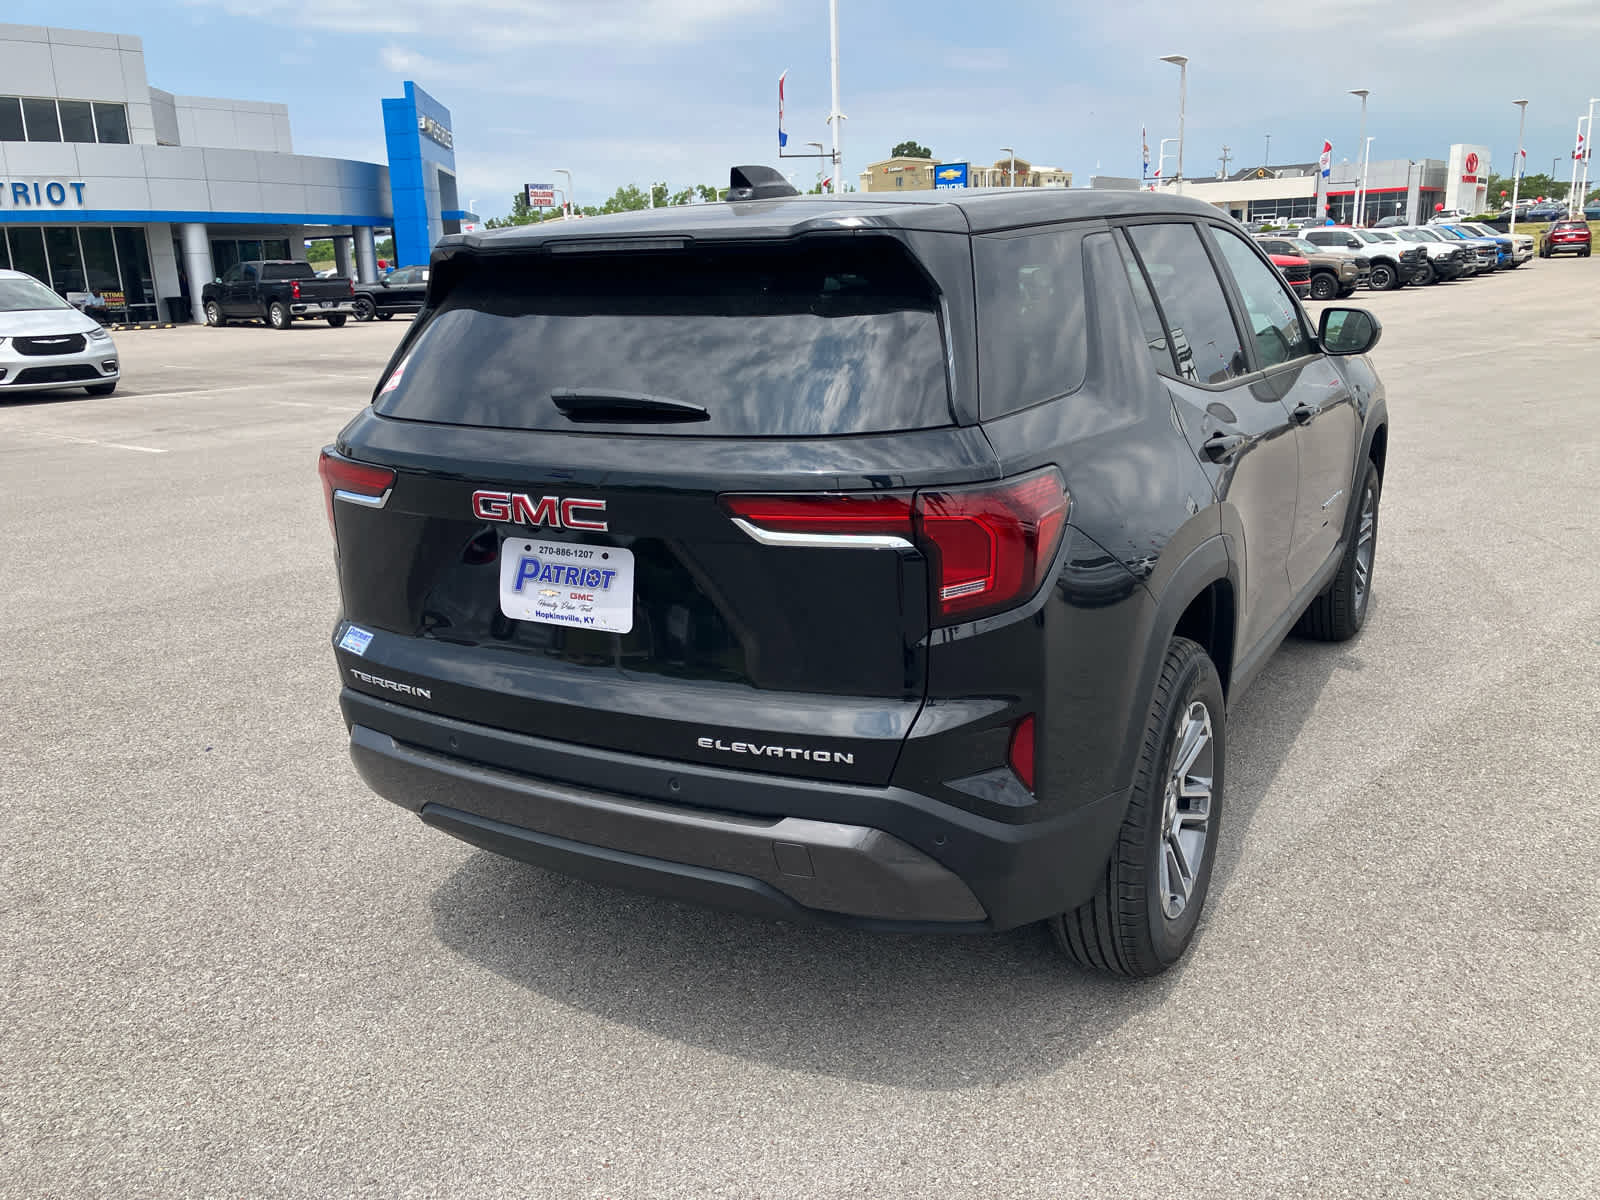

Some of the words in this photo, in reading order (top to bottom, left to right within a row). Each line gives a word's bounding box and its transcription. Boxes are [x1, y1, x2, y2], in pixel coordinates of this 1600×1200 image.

[0, 181, 87, 206] RIOT
[472, 489, 608, 532] GMC
[539, 545, 594, 559] 270-886-1207
[513, 555, 616, 593] PATRIOT
[569, 592, 594, 602] GMC
[535, 610, 582, 624] Hopkinsville,
[583, 616, 595, 624] KY
[350, 668, 432, 699] TERRAIN
[697, 737, 854, 764] ELEVATION
